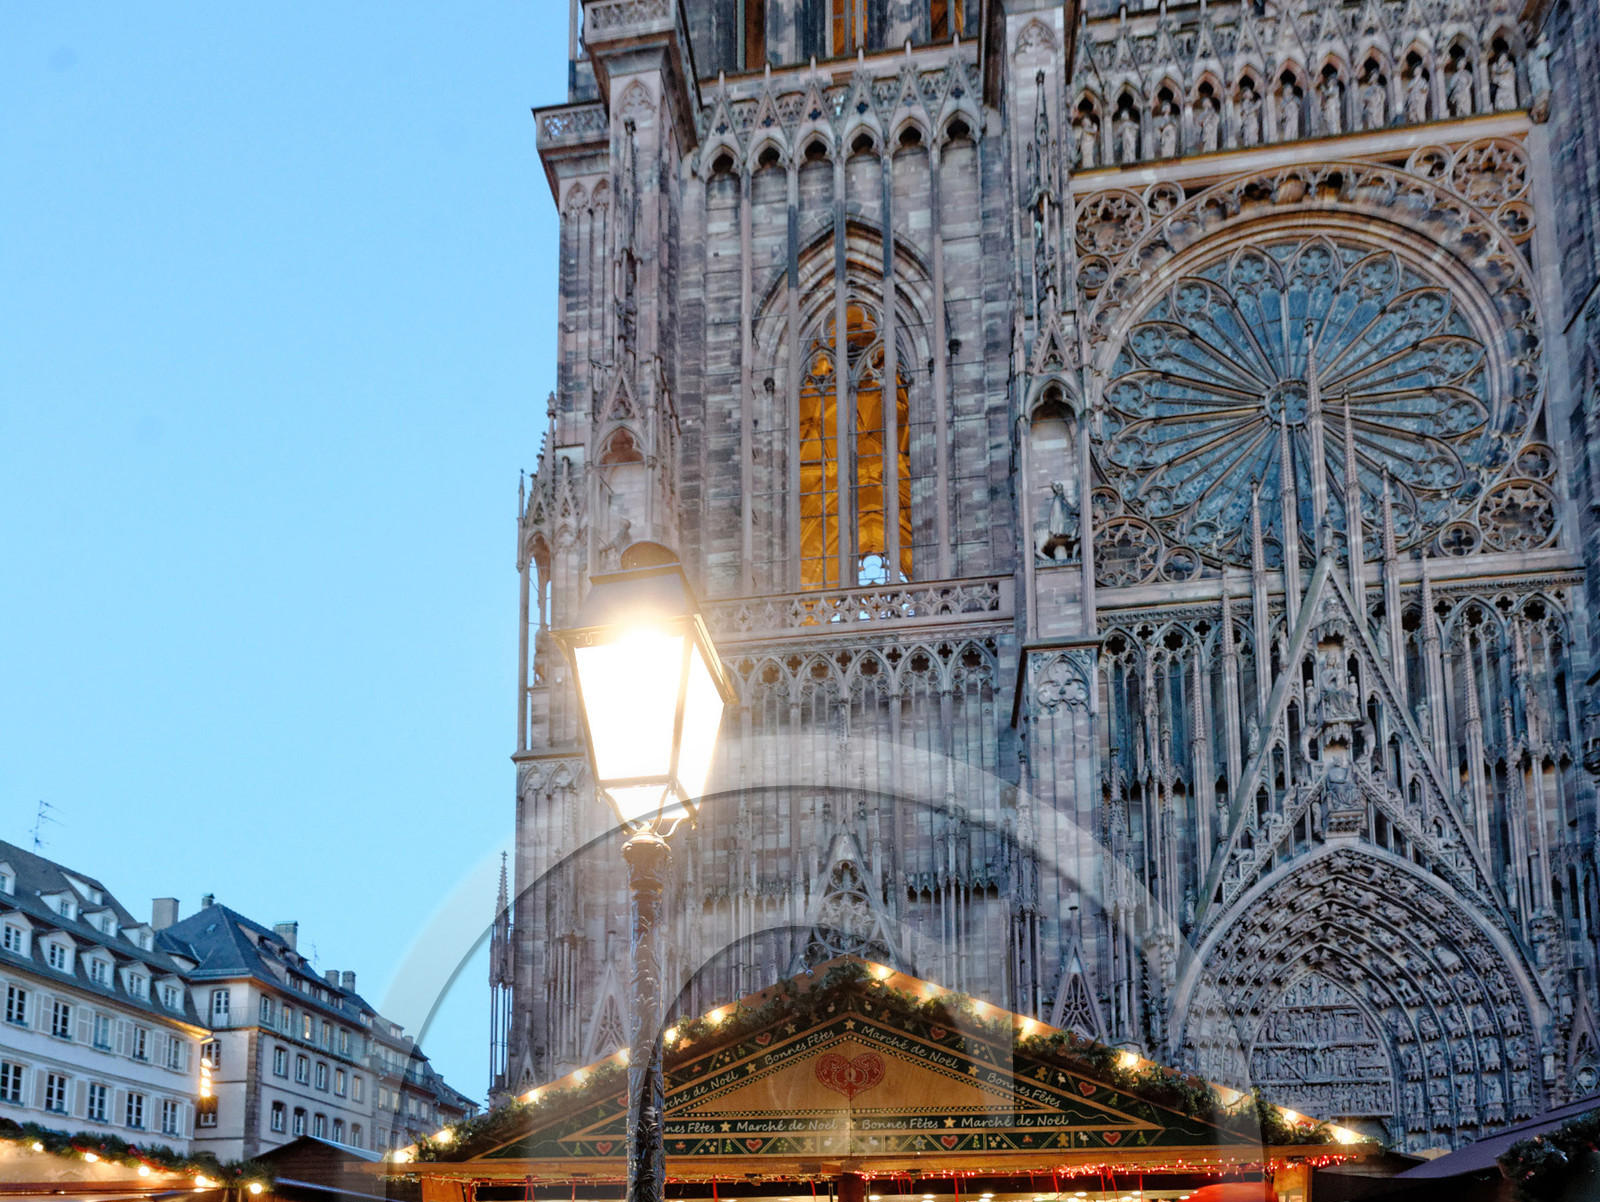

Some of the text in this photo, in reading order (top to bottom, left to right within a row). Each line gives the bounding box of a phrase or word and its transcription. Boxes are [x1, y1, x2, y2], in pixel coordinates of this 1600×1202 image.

[663, 1030, 835, 1110] rché de Noël Bonnes Fêtes
[861, 1025, 1061, 1108] Marché de Noël Bonnes Fêtes
[687, 1121, 715, 1134] Fêtes
[736, 1120, 786, 1132] Marché
[788, 1119, 806, 1131] de
[808, 1119, 838, 1131] Noël
[862, 1119, 907, 1130] Bonnes
[909, 1117, 938, 1129] Fêtes
[961, 1116, 1013, 1128] Marché
[1016, 1114, 1034, 1126] de
[1037, 1114, 1069, 1126] Noël
